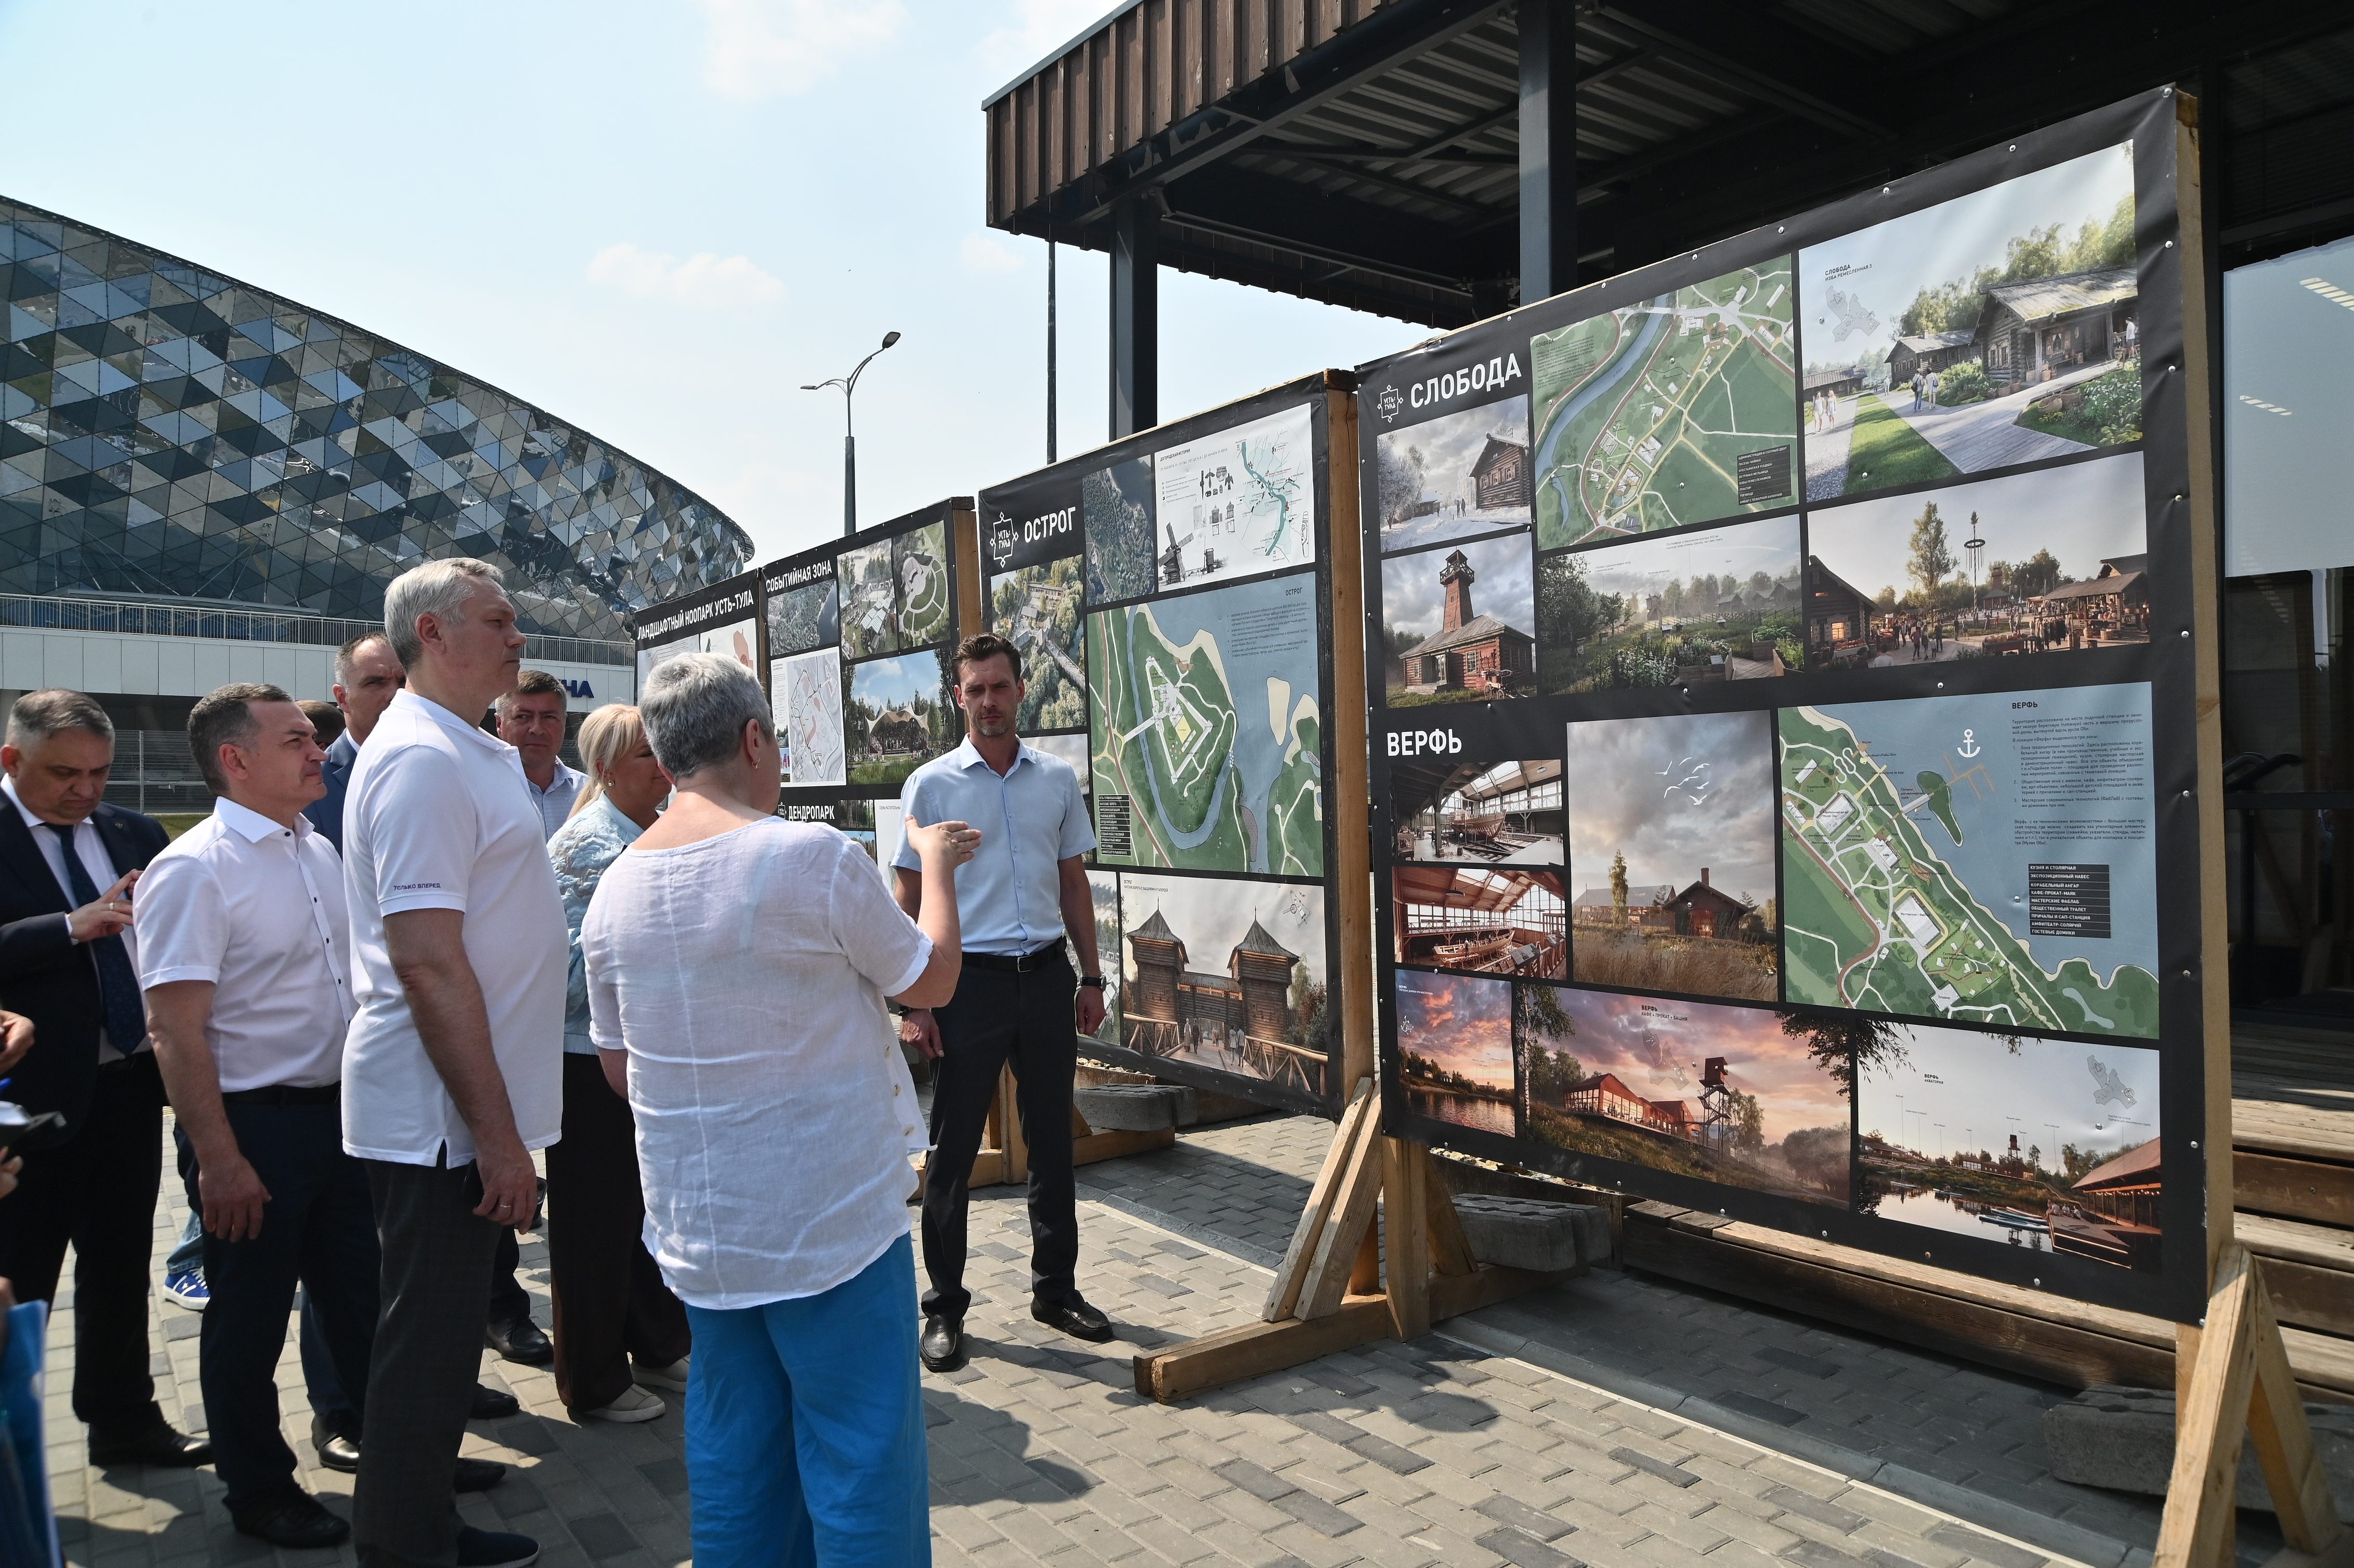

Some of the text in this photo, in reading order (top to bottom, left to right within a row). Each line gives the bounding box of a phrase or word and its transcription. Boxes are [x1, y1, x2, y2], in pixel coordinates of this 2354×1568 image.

[1825, 264, 1851, 276] СЛОБОДА
[1838, 265, 1868, 278] РЕМЕСЛЕННАЯ
[1536, 339, 1554, 347] СЛОБОДА
[1411, 353, 1522, 408] СЛОБОДА
[1384, 402, 1395, 411] ТУЛА
[1025, 506, 1076, 543] ОСТРОГ
[999, 539, 1010, 549] ТУЛА
[766, 559, 832, 593] СОБЫТИЙНАЯ ЗОНА
[1286, 587, 1302, 596] ОСТРОГ
[637, 590, 754, 640] ЛАНДШАФТНЫЙ НООПАРК УСТЬ-ТУЛА
[1387, 728, 1462, 756] ВЕРФЬ
[789, 805, 834, 821] ДЕНДРОПАРК
